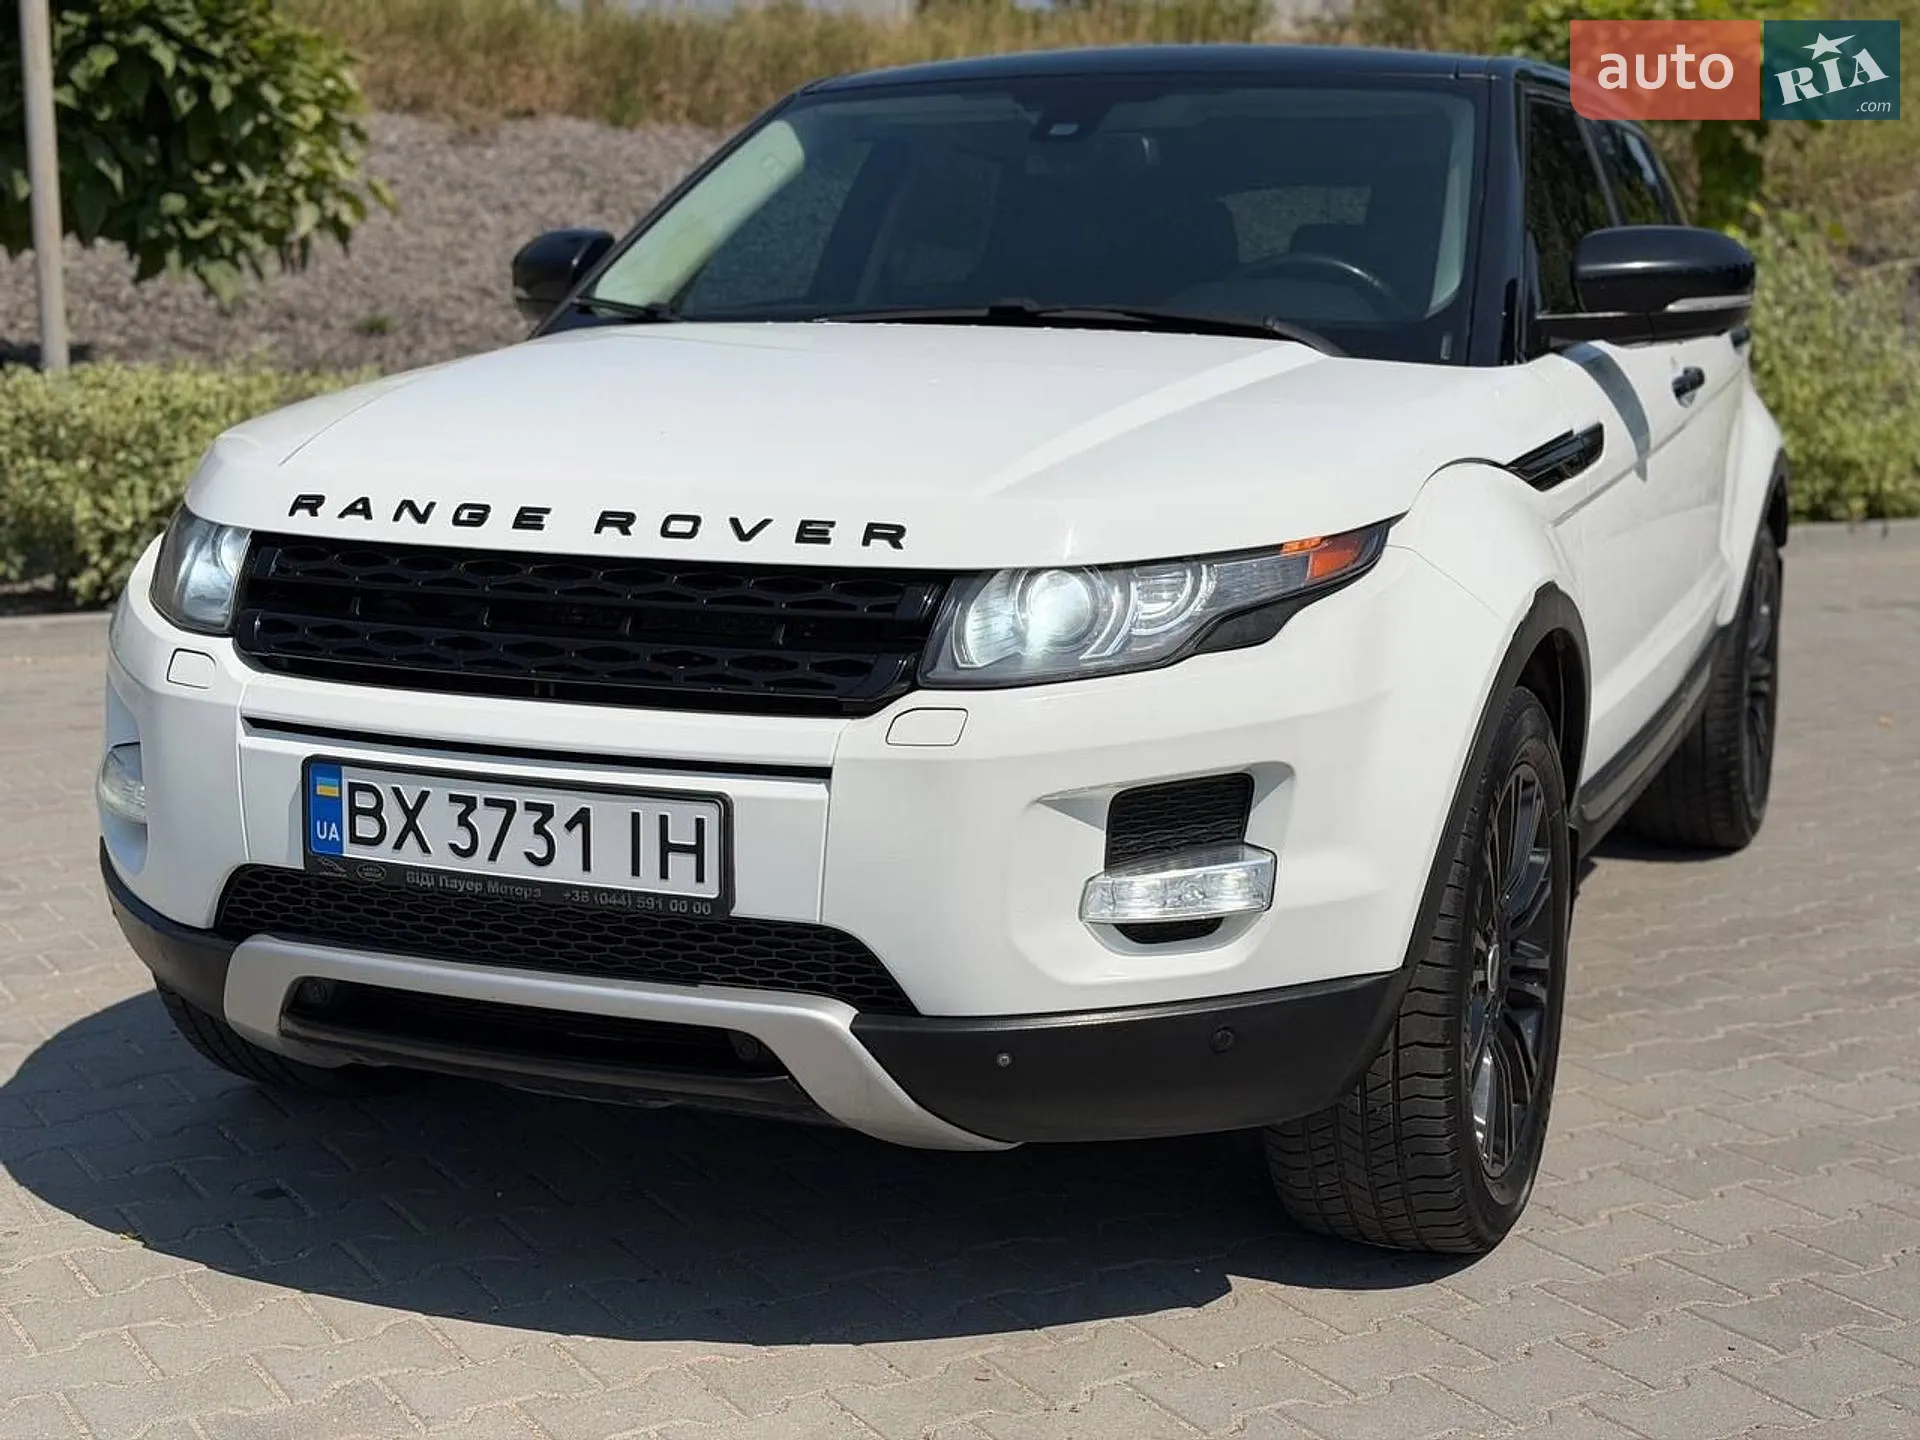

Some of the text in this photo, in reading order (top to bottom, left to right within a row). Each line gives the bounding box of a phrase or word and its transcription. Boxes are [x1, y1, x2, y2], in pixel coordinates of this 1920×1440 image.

[288, 493, 907, 550] RANGE ROVER
[316, 820, 340, 842] UA
[348, 781, 432, 855] BX
[447, 793, 592, 873] 3731
[637, 896, 664, 911] 591
[669, 899, 689, 913] 00
[692, 901, 712, 915] 00
